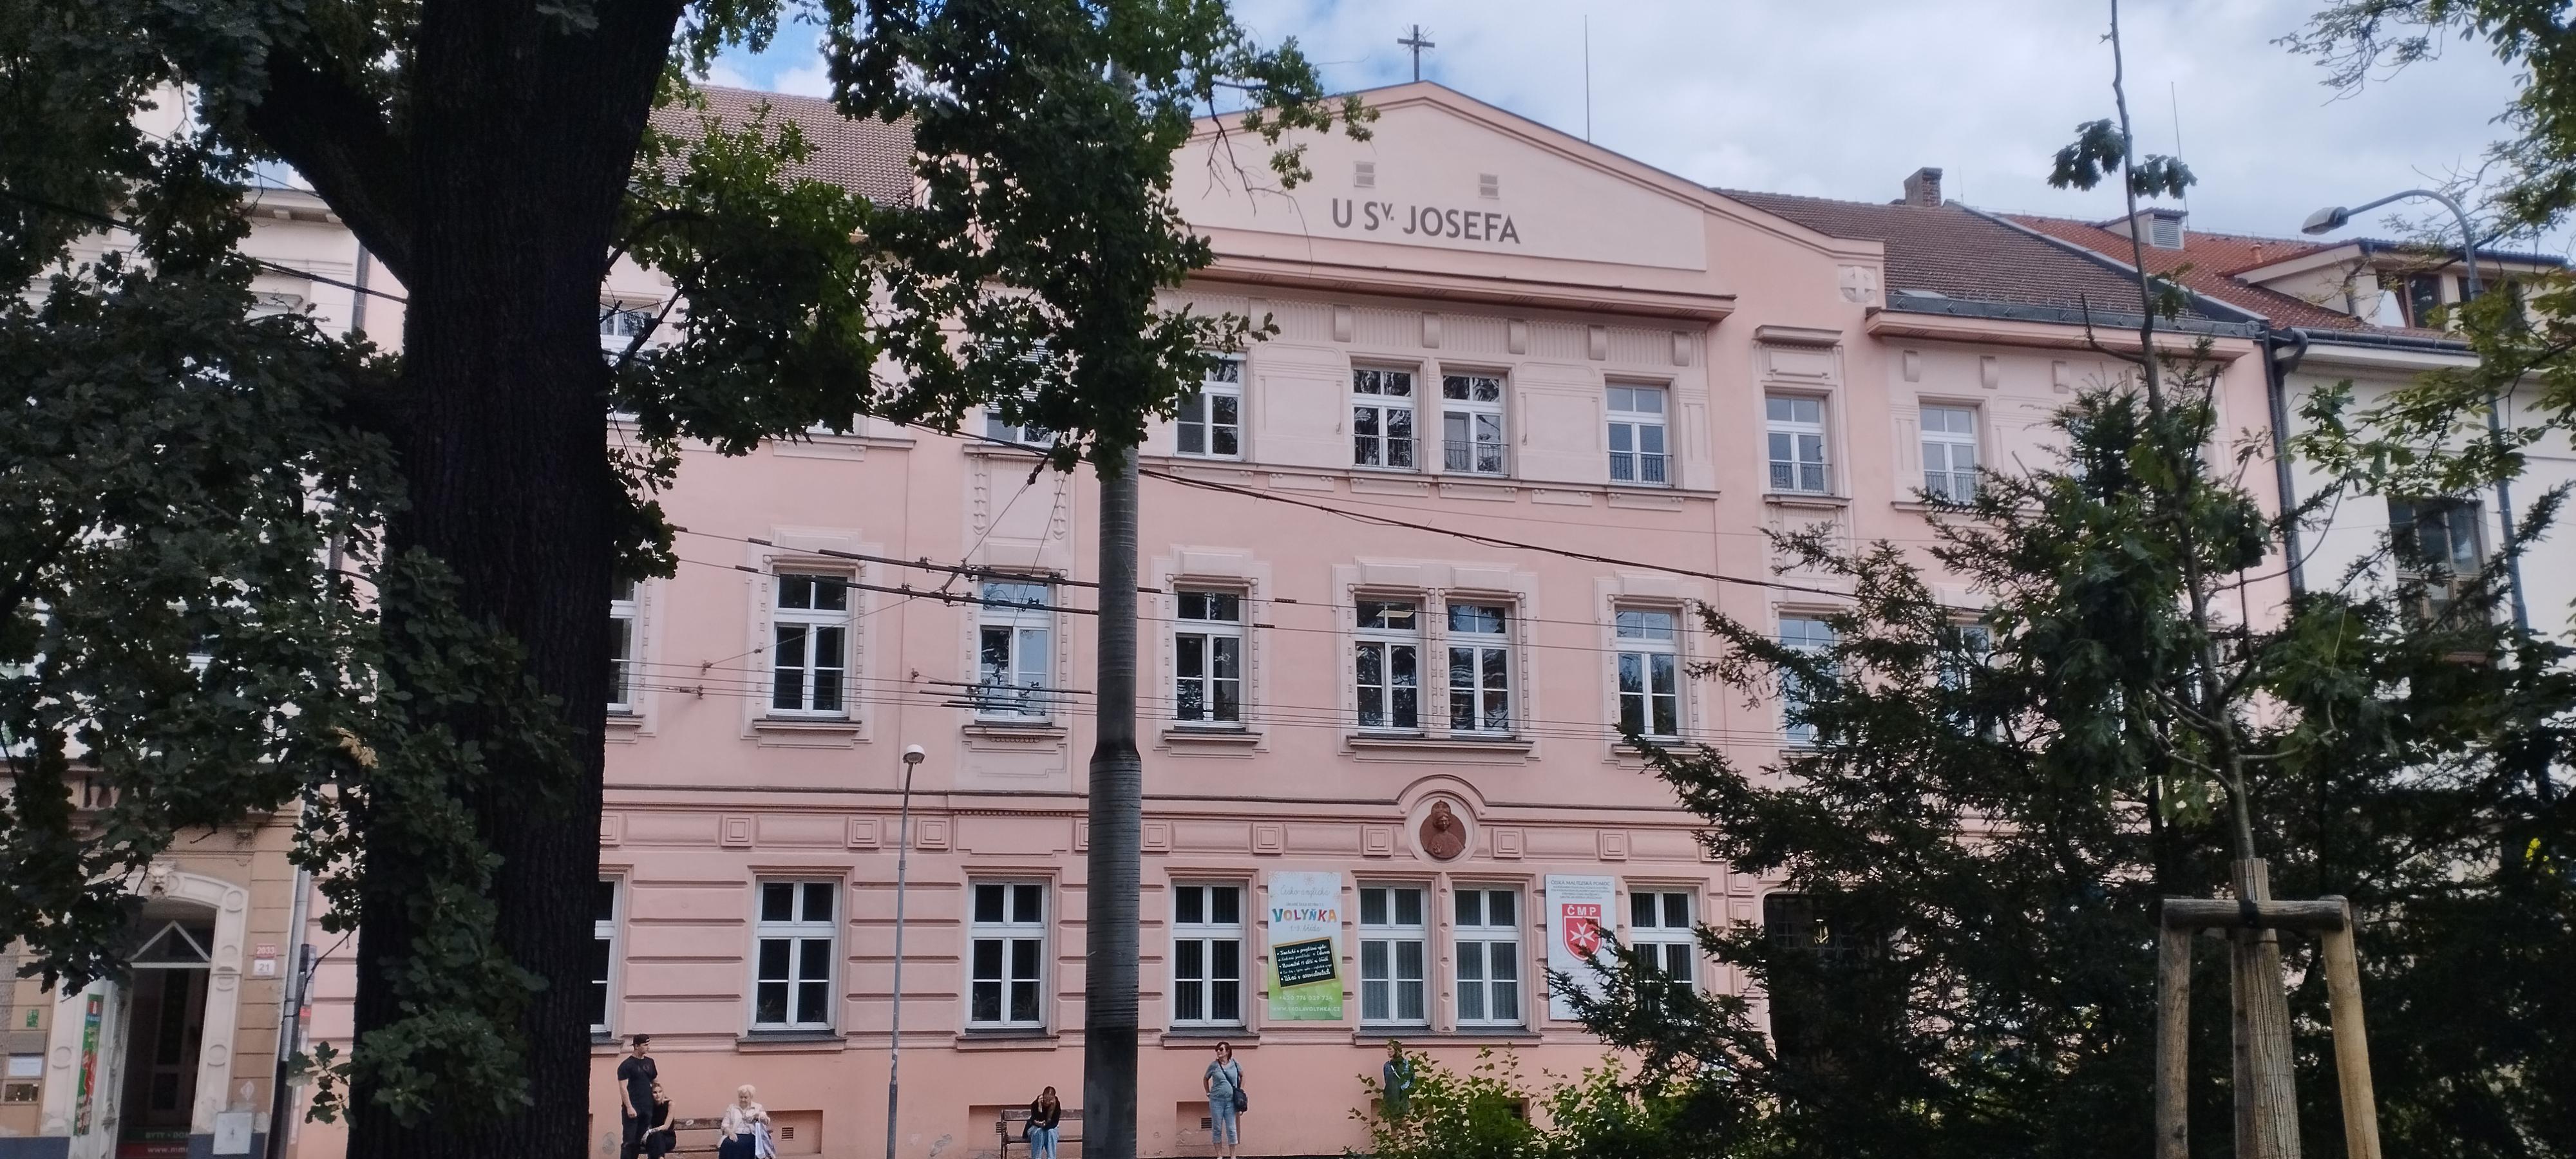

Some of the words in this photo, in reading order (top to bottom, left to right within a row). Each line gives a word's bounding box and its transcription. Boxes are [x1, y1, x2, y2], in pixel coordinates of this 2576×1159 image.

[1332, 198, 1352, 228] U
[1403, 205, 1520, 244] JOSEFA
[1272, 909, 1337, 923] VOLYŇKA
[1567, 905, 1596, 916] ČMP
